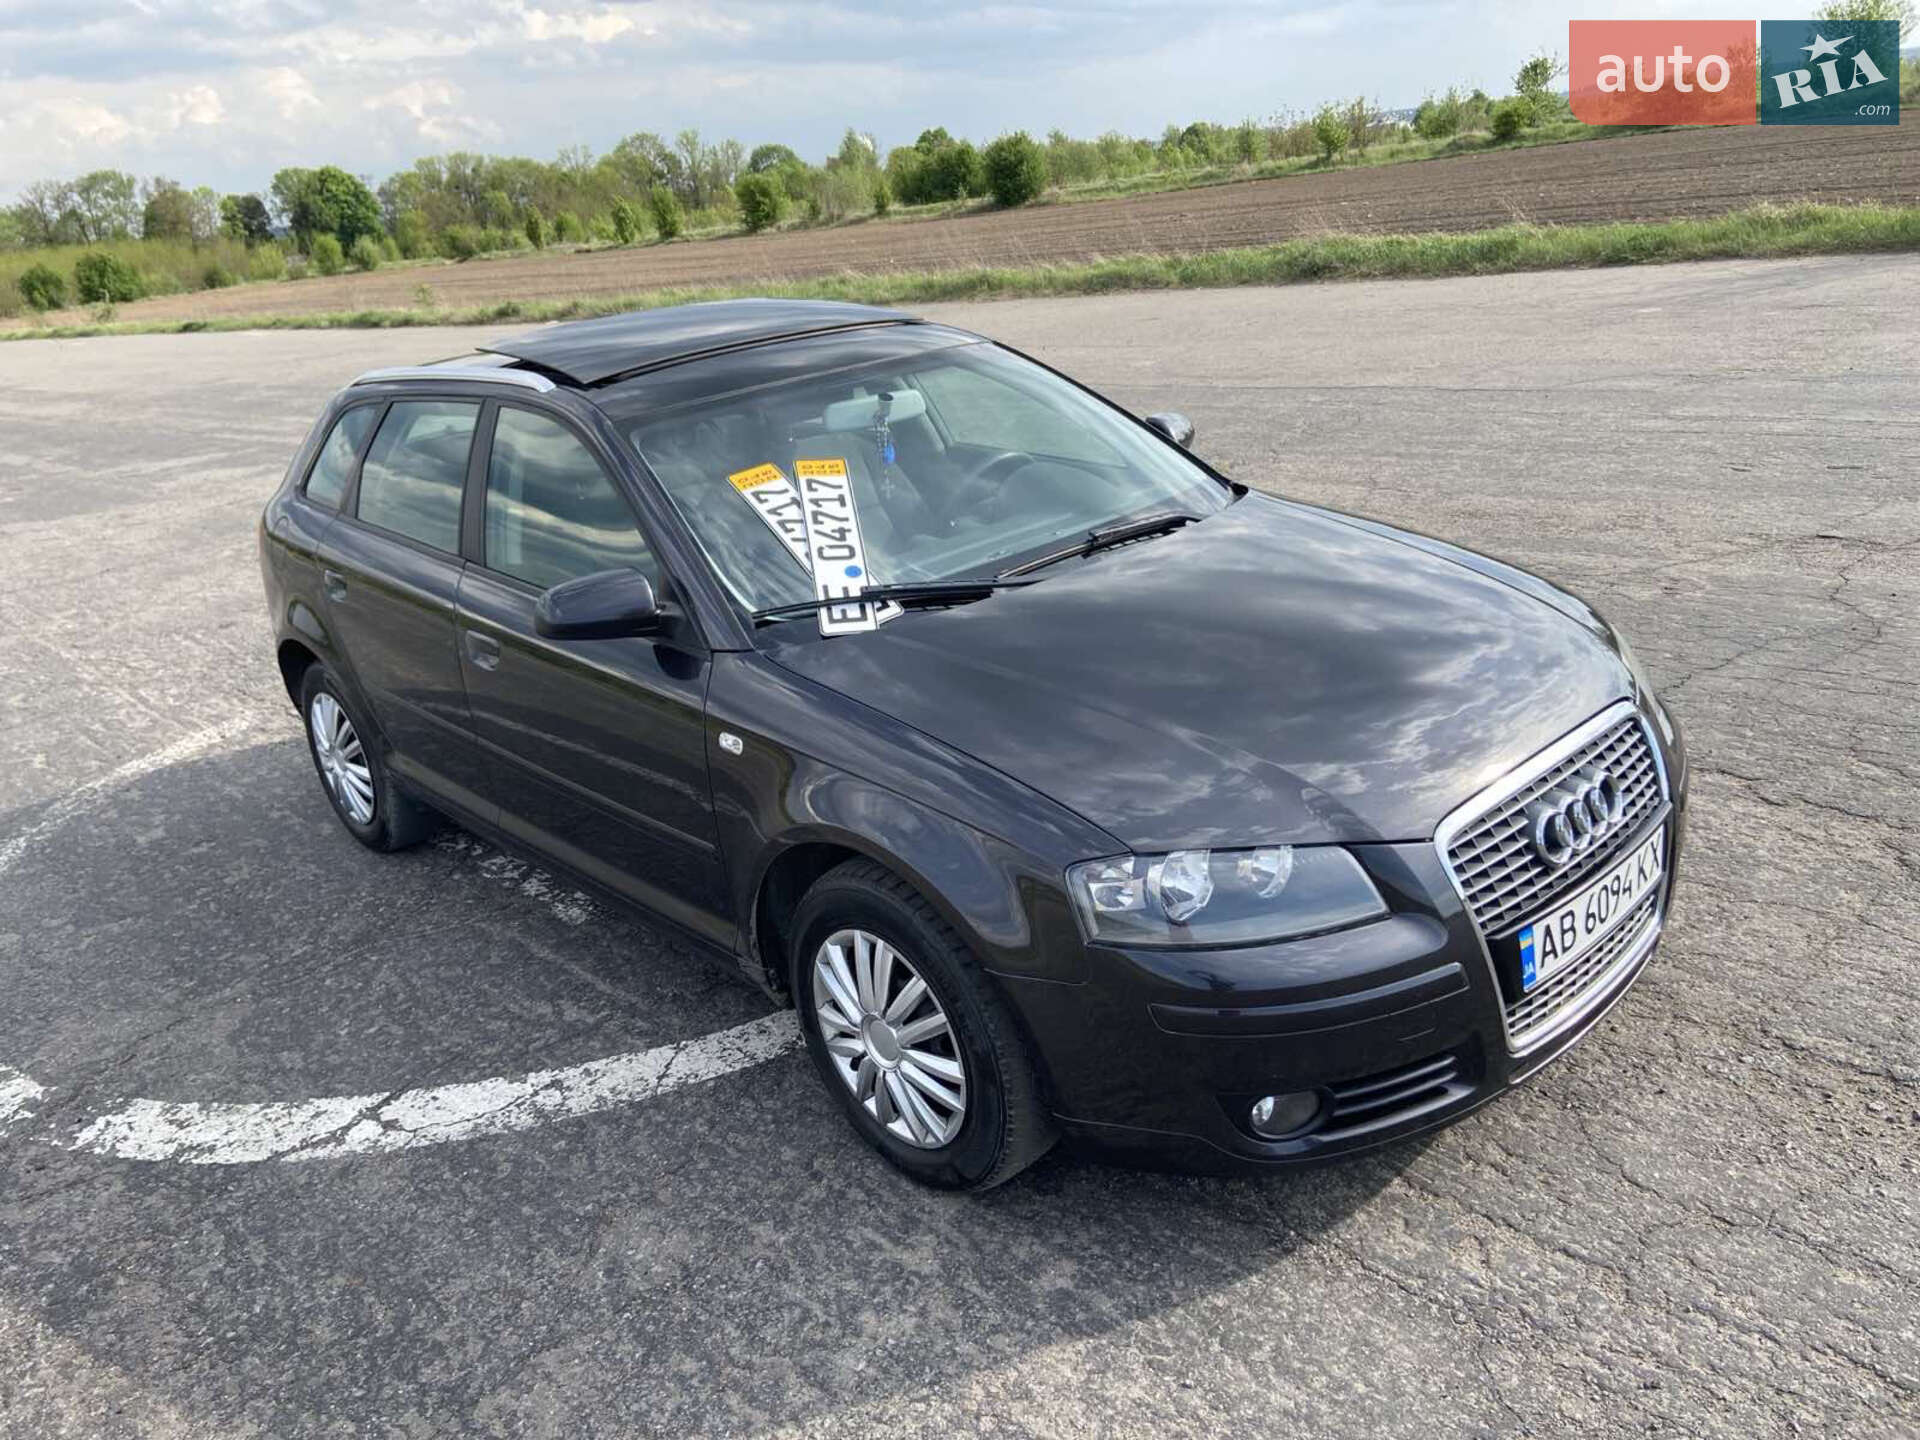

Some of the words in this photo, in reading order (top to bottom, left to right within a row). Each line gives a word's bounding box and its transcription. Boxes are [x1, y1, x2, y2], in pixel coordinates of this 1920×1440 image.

[805, 477, 857, 561] 04717
[1540, 909, 1577, 969] AB
[1585, 862, 1633, 935] 6094
[1637, 832, 1661, 889] KX
